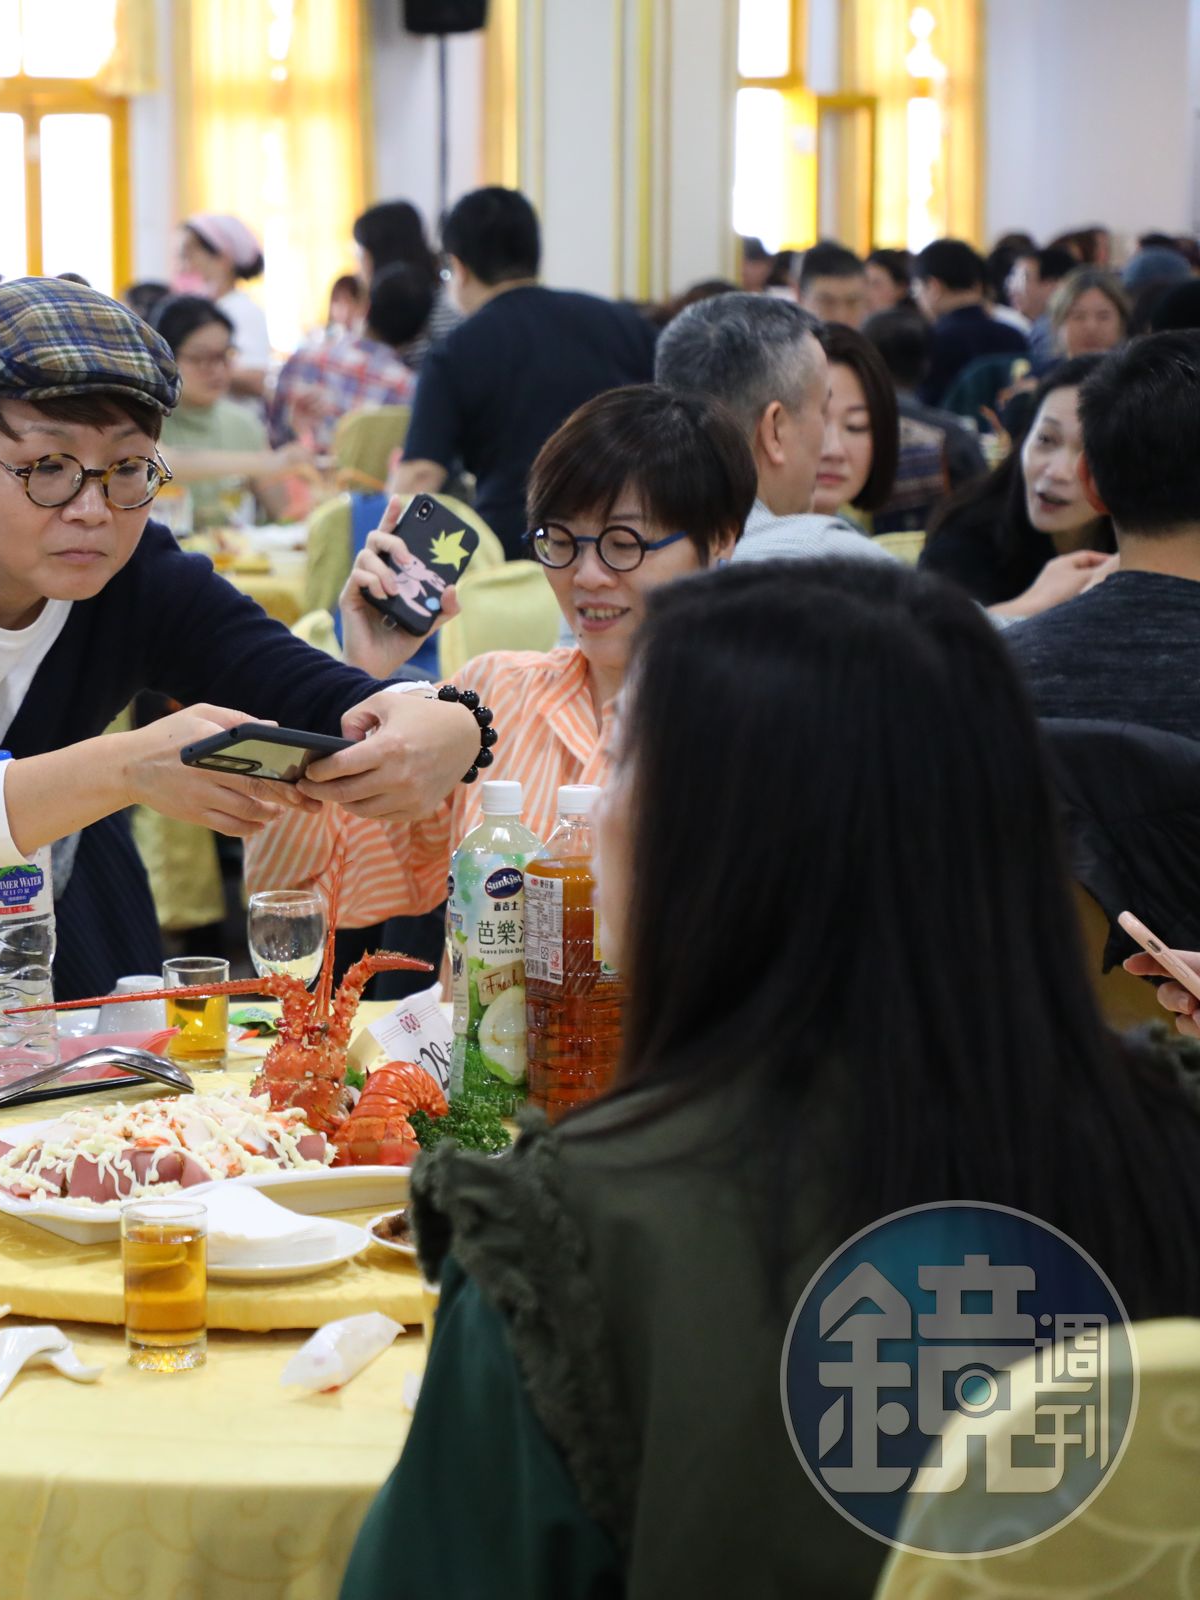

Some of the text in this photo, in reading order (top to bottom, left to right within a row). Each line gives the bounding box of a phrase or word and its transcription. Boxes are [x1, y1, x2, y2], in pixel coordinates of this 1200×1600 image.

[19, 875, 42, 887] WATER
[486, 873, 522, 893] Sunkist
[498, 947, 514, 955] Juice
[483, 968, 520, 995] Fresh
